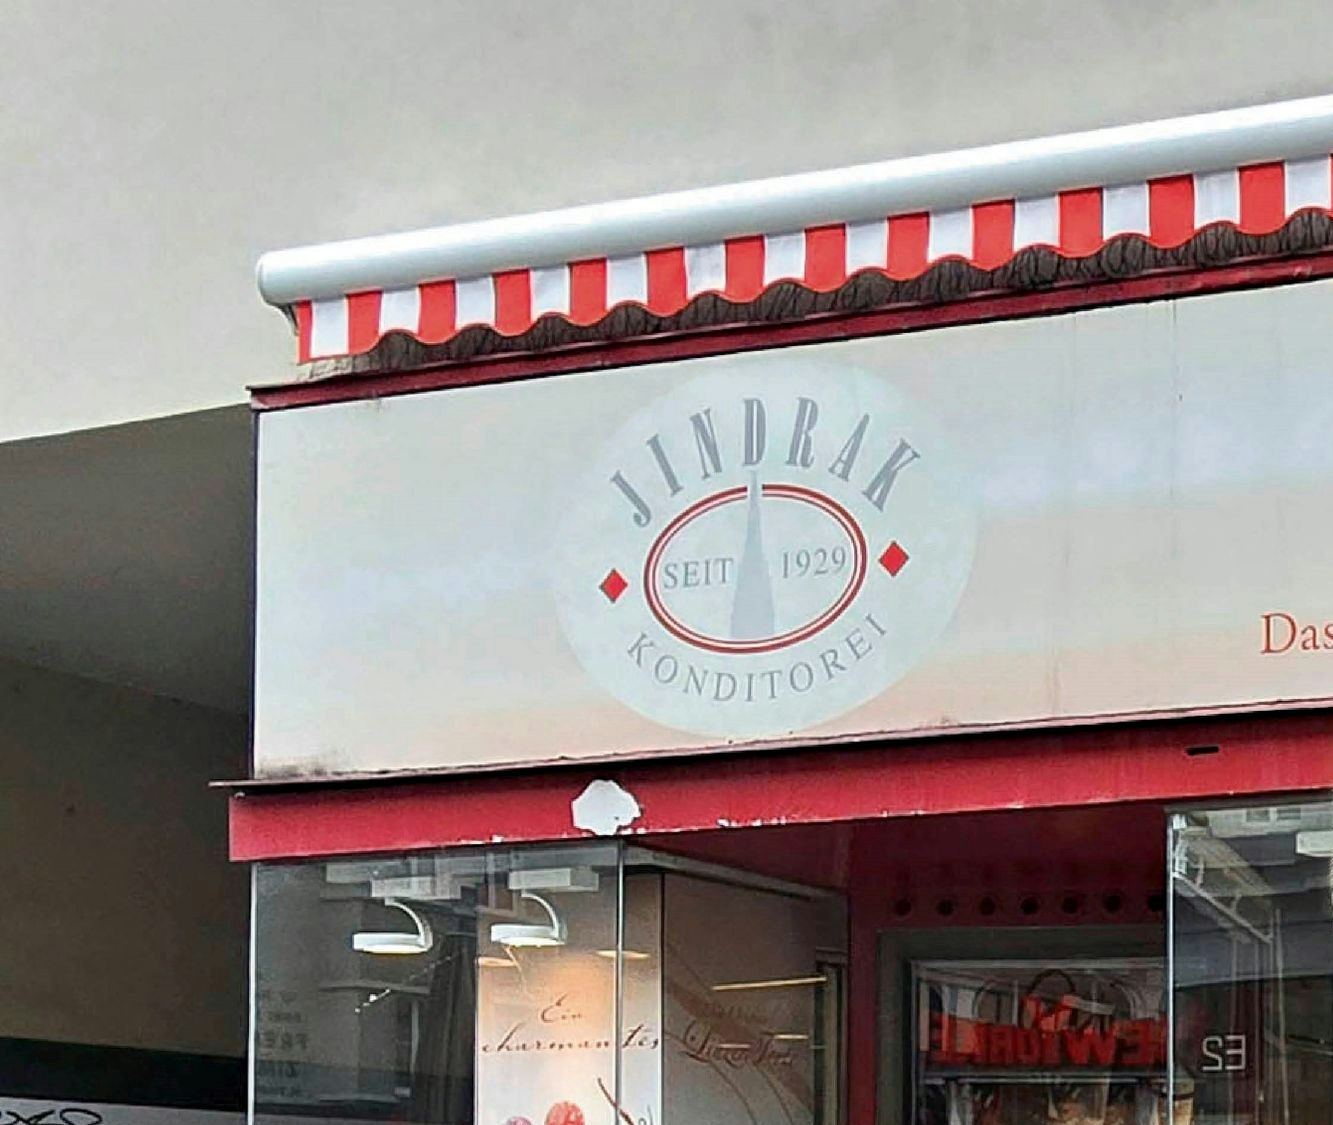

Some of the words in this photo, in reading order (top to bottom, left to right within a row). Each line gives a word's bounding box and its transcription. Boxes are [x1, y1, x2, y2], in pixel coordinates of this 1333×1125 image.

[610, 396, 922, 529] JINDRAK
[662, 556, 734, 590] SEIT
[778, 546, 846, 580] 1929
[627, 612, 886, 703] KONDITOREI
